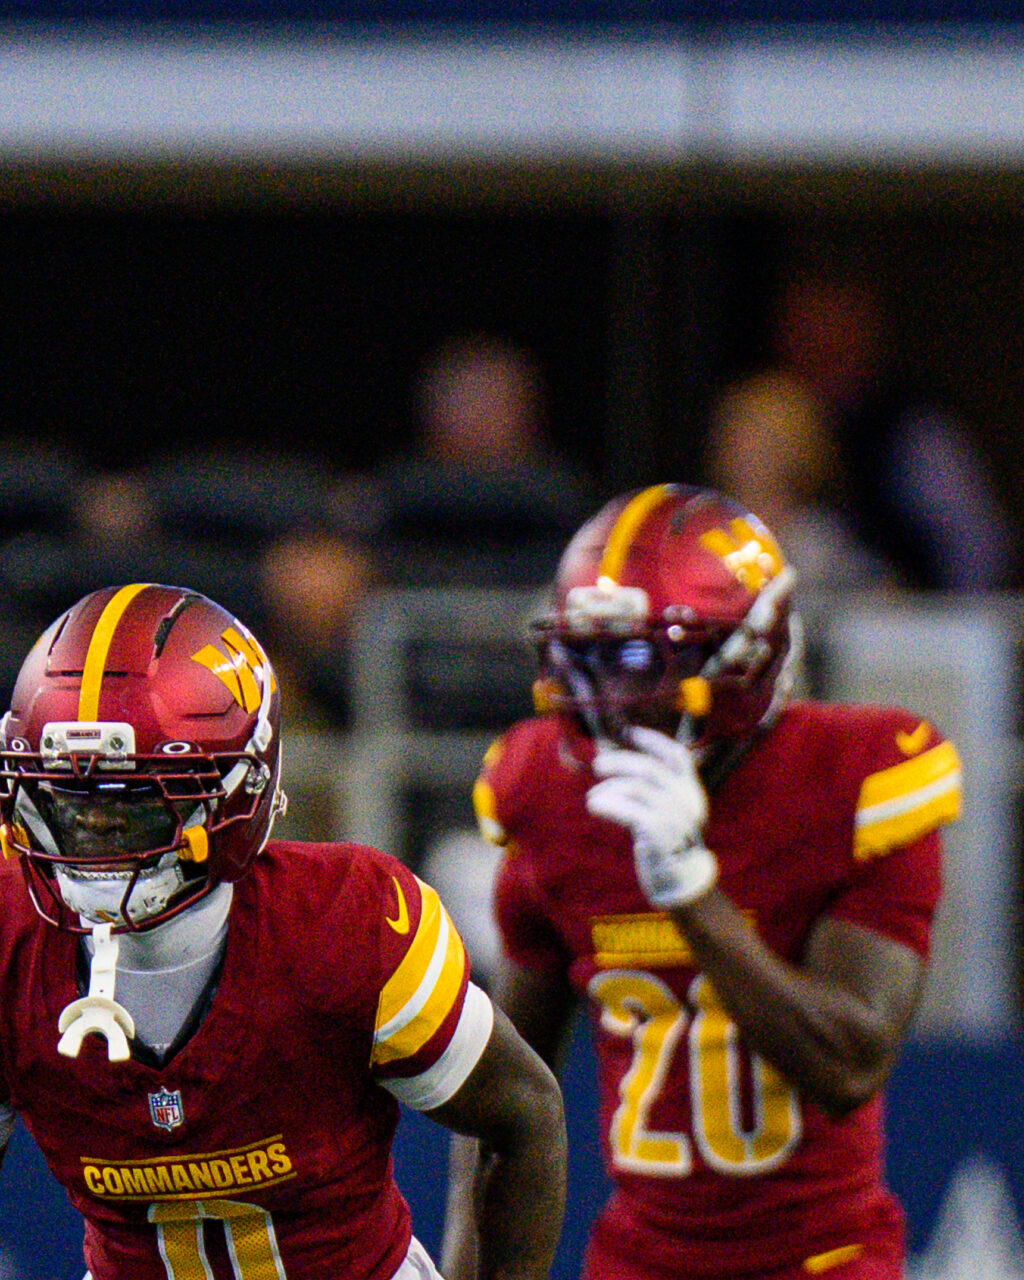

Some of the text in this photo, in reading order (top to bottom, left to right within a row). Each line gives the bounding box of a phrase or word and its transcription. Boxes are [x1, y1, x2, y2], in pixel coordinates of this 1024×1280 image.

[588, 970, 801, 1176] 20
[155, 1105, 179, 1123] NFL
[83, 1142, 293, 1196] COMMANDERS
